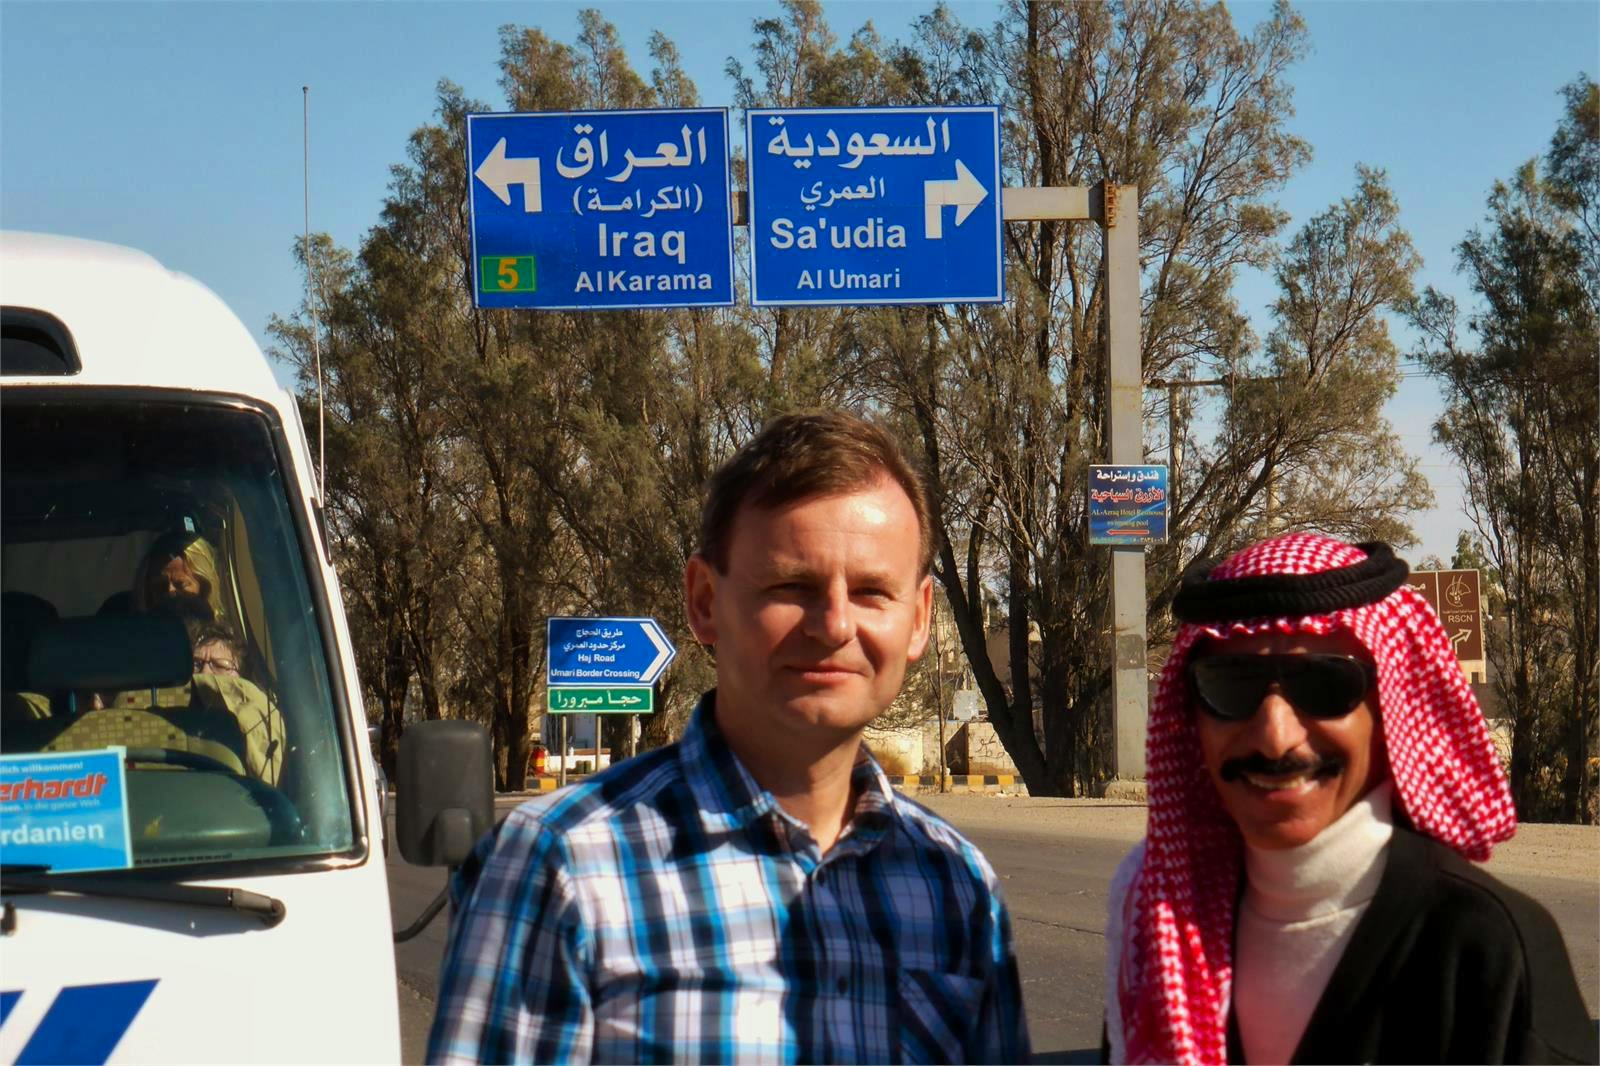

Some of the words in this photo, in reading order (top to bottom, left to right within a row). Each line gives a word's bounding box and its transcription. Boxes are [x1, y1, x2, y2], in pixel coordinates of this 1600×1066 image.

[767, 115, 951, 169] السعودية
[556, 123, 707, 182] العراق
[573, 183, 703, 216] (الكرامة)
[800, 175, 885, 211] العمري
[770, 217, 906, 249] Sa'udia
[598, 223, 686, 264] Iraq
[497, 258, 519, 291] 5
[608, 270, 712, 291] Karama
[796, 269, 822, 289] Al
[828, 268, 901, 289] Umari
[1136, 469, 1159, 482] فندق
[1091, 488, 1133, 503] السياحية
[1448, 614, 1473, 622] RSCN
[576, 628, 600, 637] الحجاج
[601, 628, 623, 638] طريق
[588, 641, 609, 651] حدود
[609, 641, 626, 651] مركز
[578, 654, 592, 664] Haj
[594, 654, 615, 662] Road
[551, 669, 575, 677] Umari
[576, 668, 603, 678] Border
[603, 668, 640, 679] Crossing
